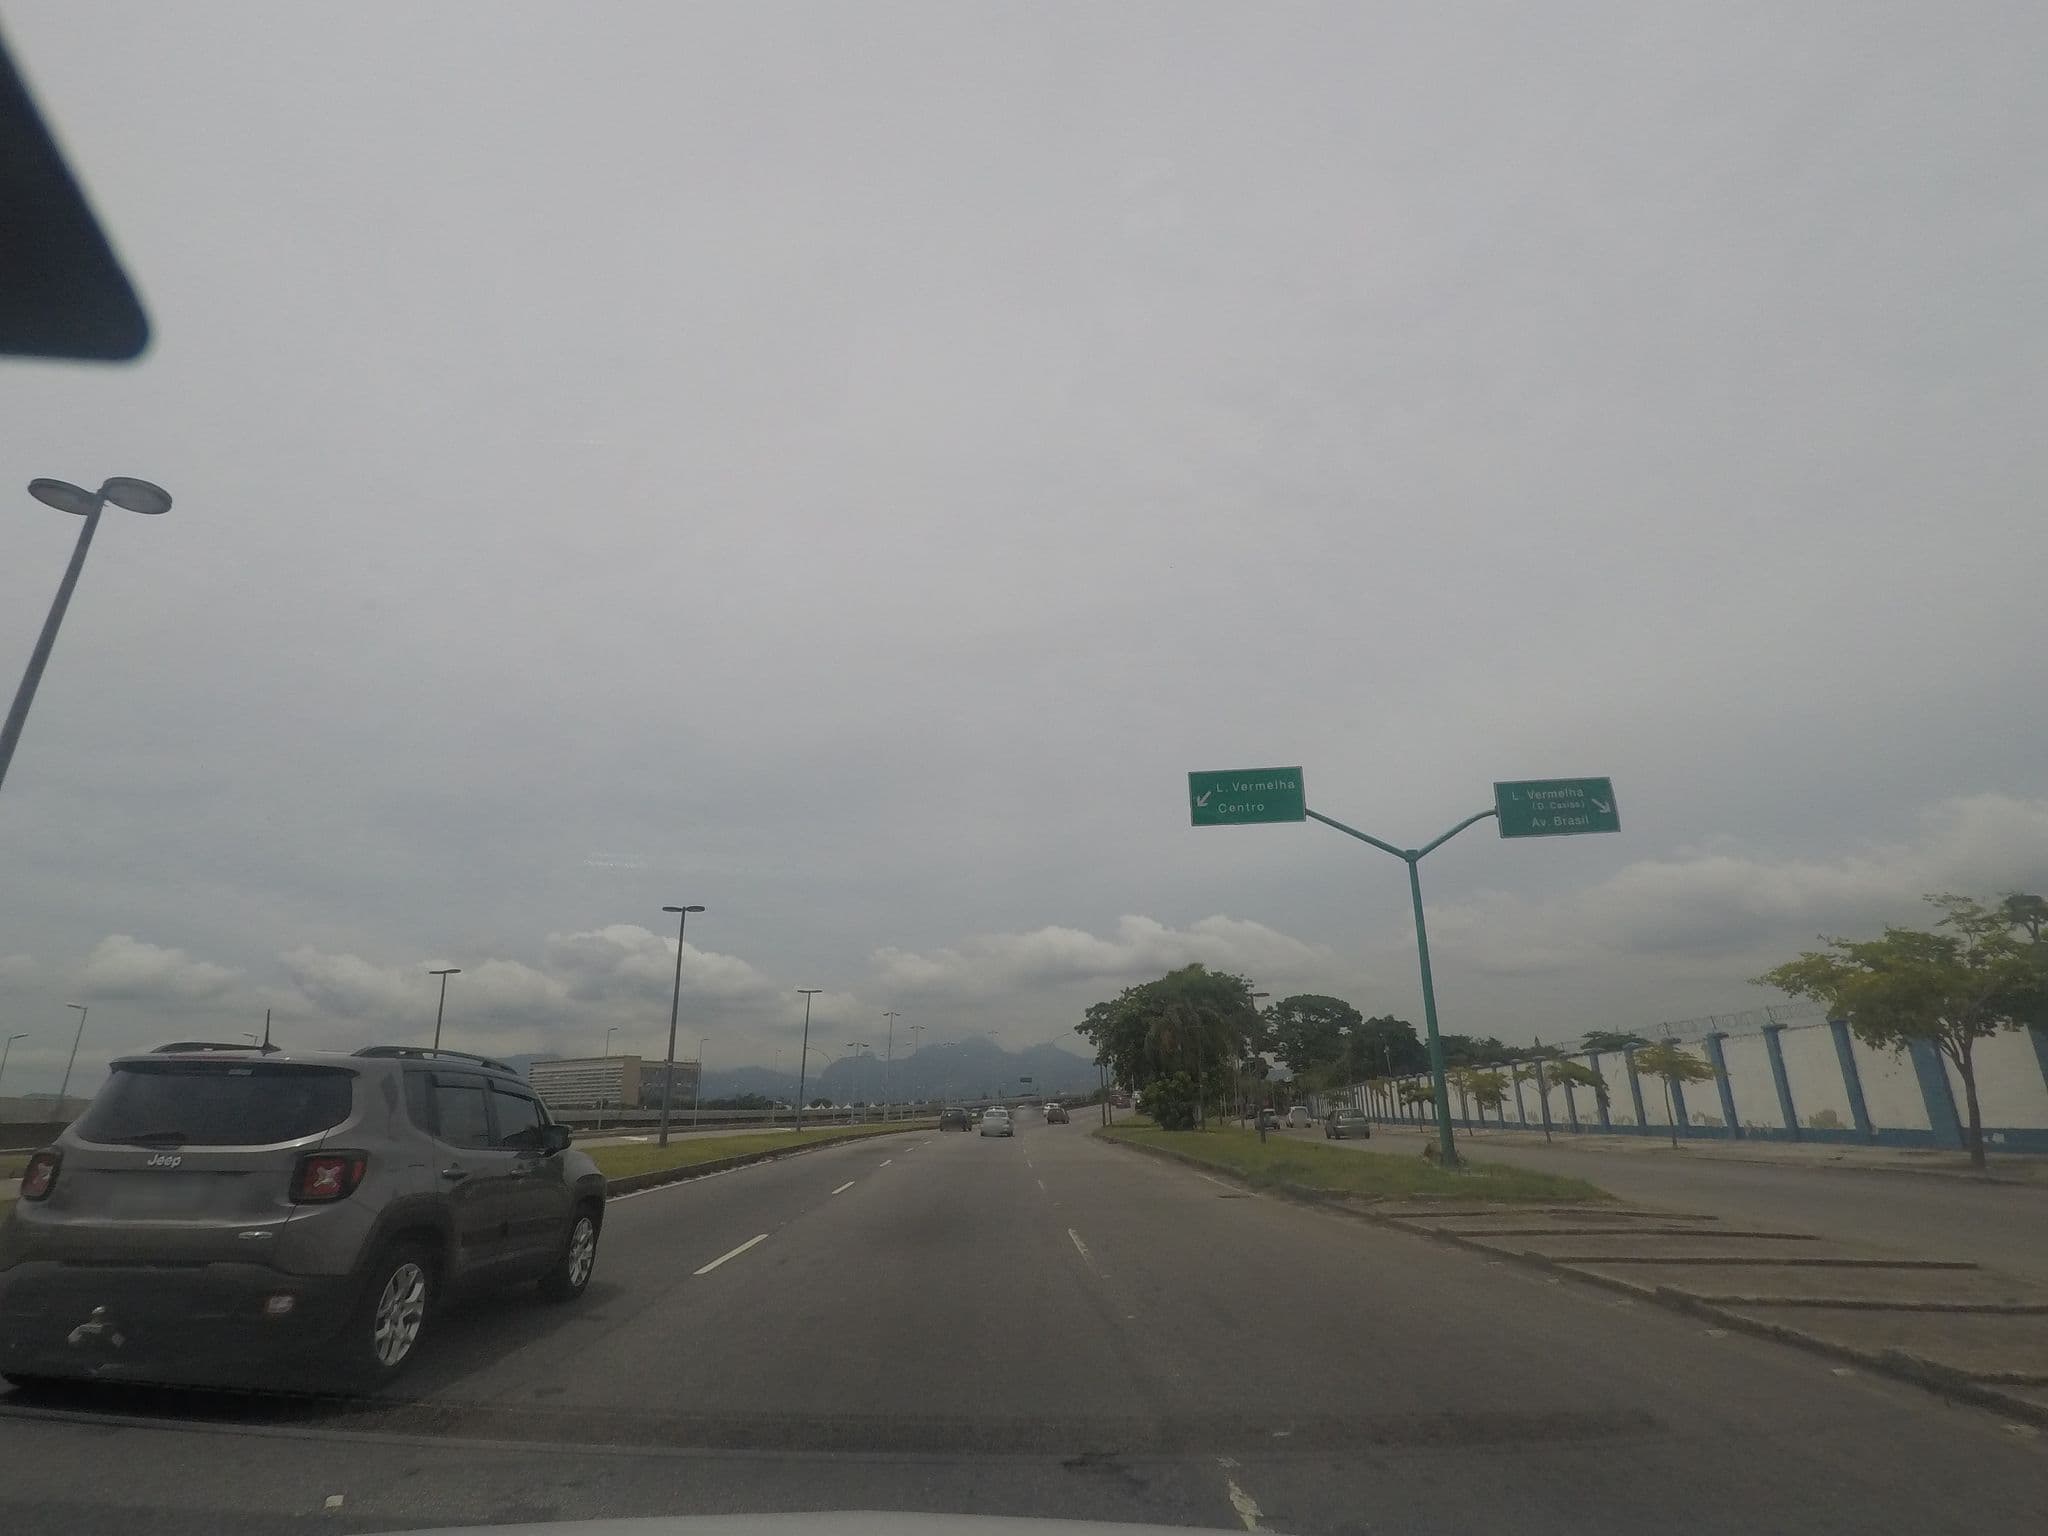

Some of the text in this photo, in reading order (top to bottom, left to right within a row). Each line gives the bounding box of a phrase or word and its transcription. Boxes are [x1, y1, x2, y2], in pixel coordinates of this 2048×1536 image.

[1216, 779, 1295, 792] L. Vermelha
[1526, 788, 1584, 800] Vermelha
[1217, 802, 1262, 813] Centro
[1553, 814, 1590, 826] Brasil
[147, 1153, 181, 1169] Jeep
